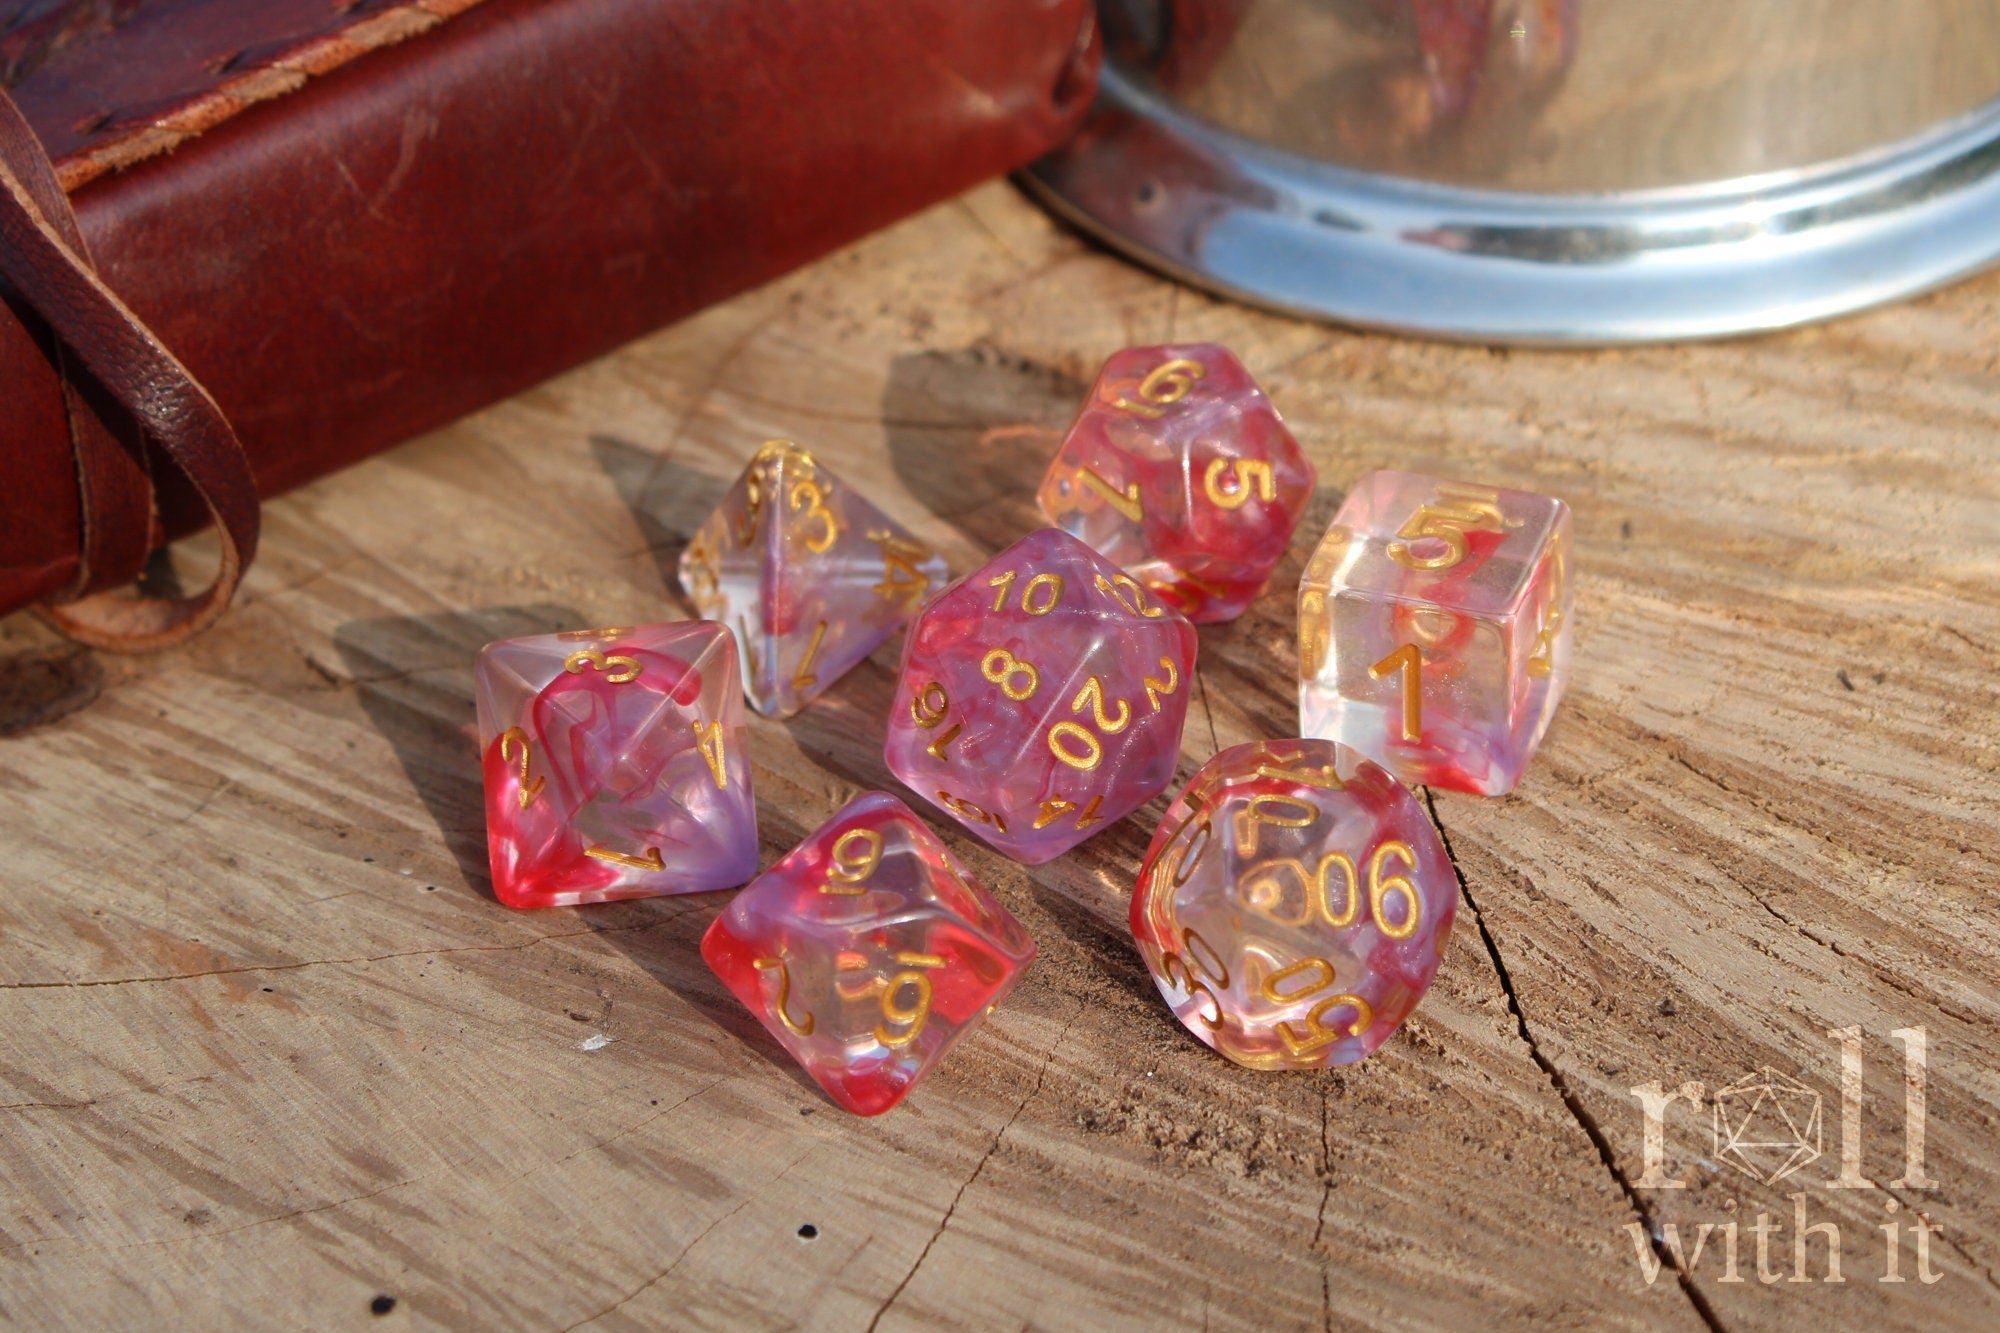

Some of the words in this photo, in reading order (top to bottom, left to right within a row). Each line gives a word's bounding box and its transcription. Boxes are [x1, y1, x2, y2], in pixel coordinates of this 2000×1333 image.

[1204, 457, 1277, 510] 5
[791, 480, 837, 553] 3
[1385, 503, 1485, 571] 5
[988, 569, 1066, 616] 10
[1093, 573, 1165, 618] 12
[563, 649, 644, 685] 3
[980, 649, 1041, 702] 8
[1143, 655, 1179, 713] 2
[1367, 642, 1423, 744] 1
[692, 718, 728, 791] 4
[1047, 675, 1133, 772] 20
[501, 725, 546, 811] 2
